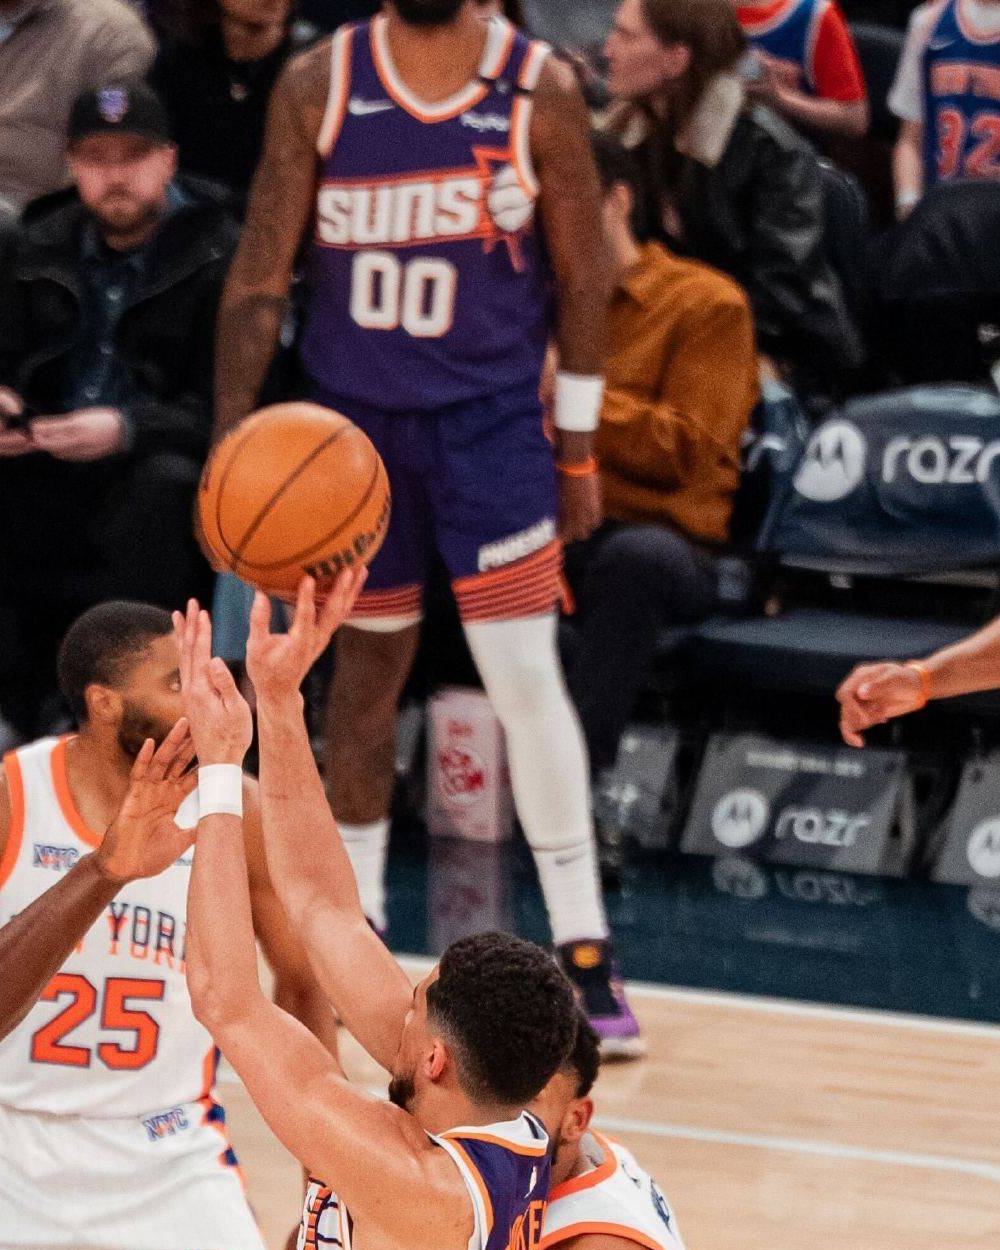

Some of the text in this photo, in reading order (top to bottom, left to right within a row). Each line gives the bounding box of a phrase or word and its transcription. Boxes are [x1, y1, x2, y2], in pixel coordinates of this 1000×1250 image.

[351, 251, 456, 338] 00
[882, 435, 1000, 483] razr
[774, 808, 869, 846] razr
[107, 901, 188, 974] YOR
[31, 973, 166, 1071] 25
